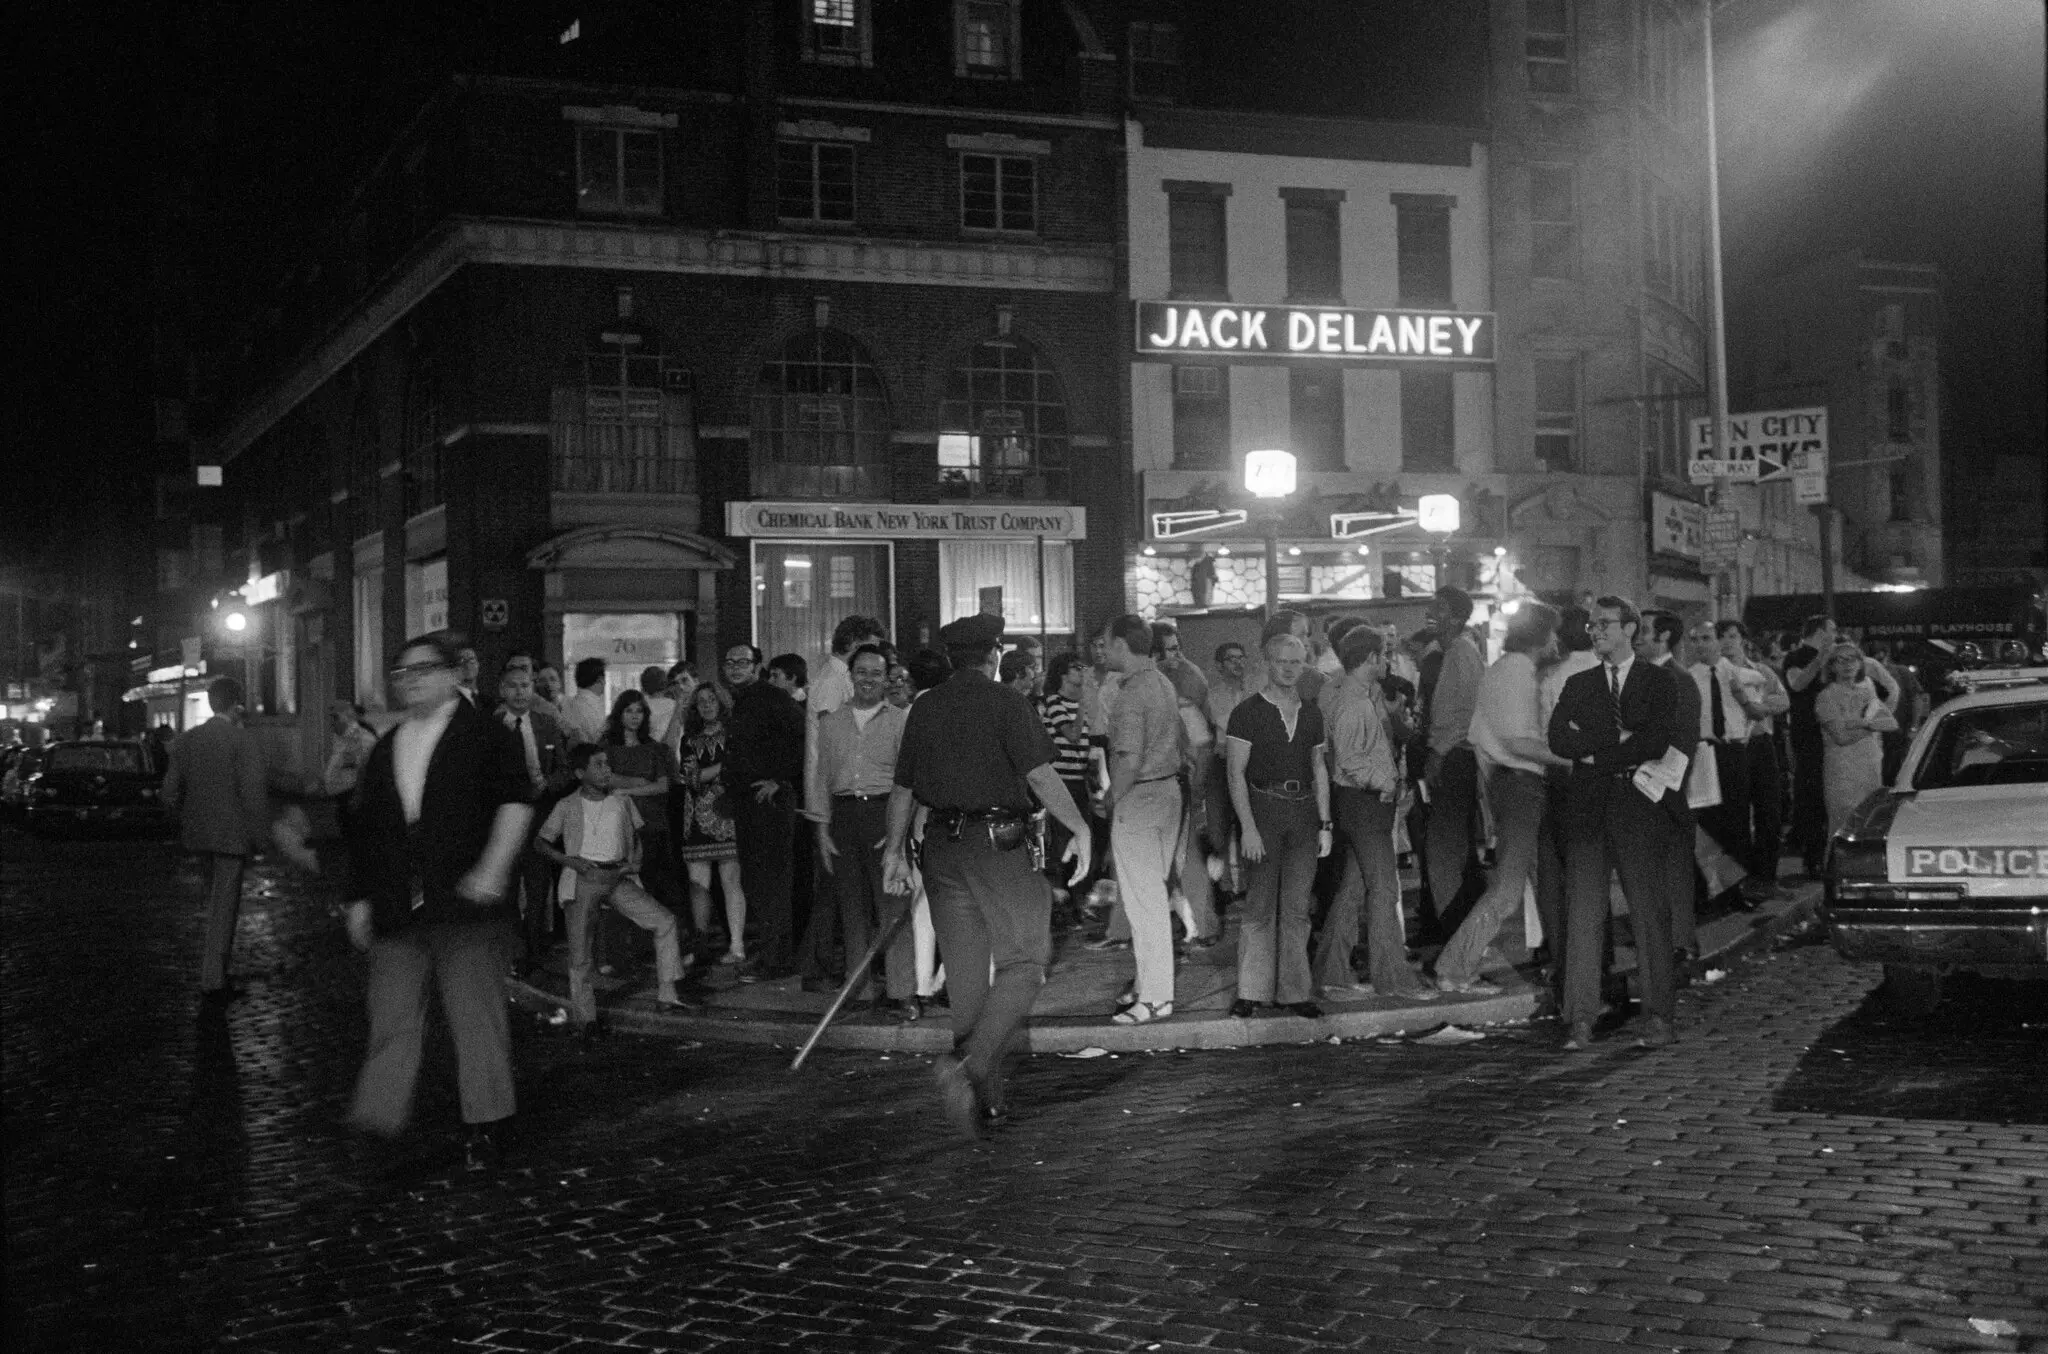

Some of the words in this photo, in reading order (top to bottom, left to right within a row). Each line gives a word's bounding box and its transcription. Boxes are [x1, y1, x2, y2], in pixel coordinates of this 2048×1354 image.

[1149, 307, 1268, 350] JACK
[1288, 311, 1483, 356] DELANEY
[1700, 420, 1749, 444] FN
[1762, 414, 1822, 437] CITY
[1692, 462, 1716, 473] ONE
[1727, 463, 1752, 474] WAY
[758, 509, 831, 528] CHEMICAL
[836, 511, 873, 529] BANK
[877, 511, 910, 529] NEW
[912, 511, 949, 530] YORK
[953, 513, 996, 530] TRUST
[1000, 514, 1063, 531] COMPANY
[1931, 623, 2014, 633] PLAYHOUSE
[1911, 849, 2048, 875] POLICE
